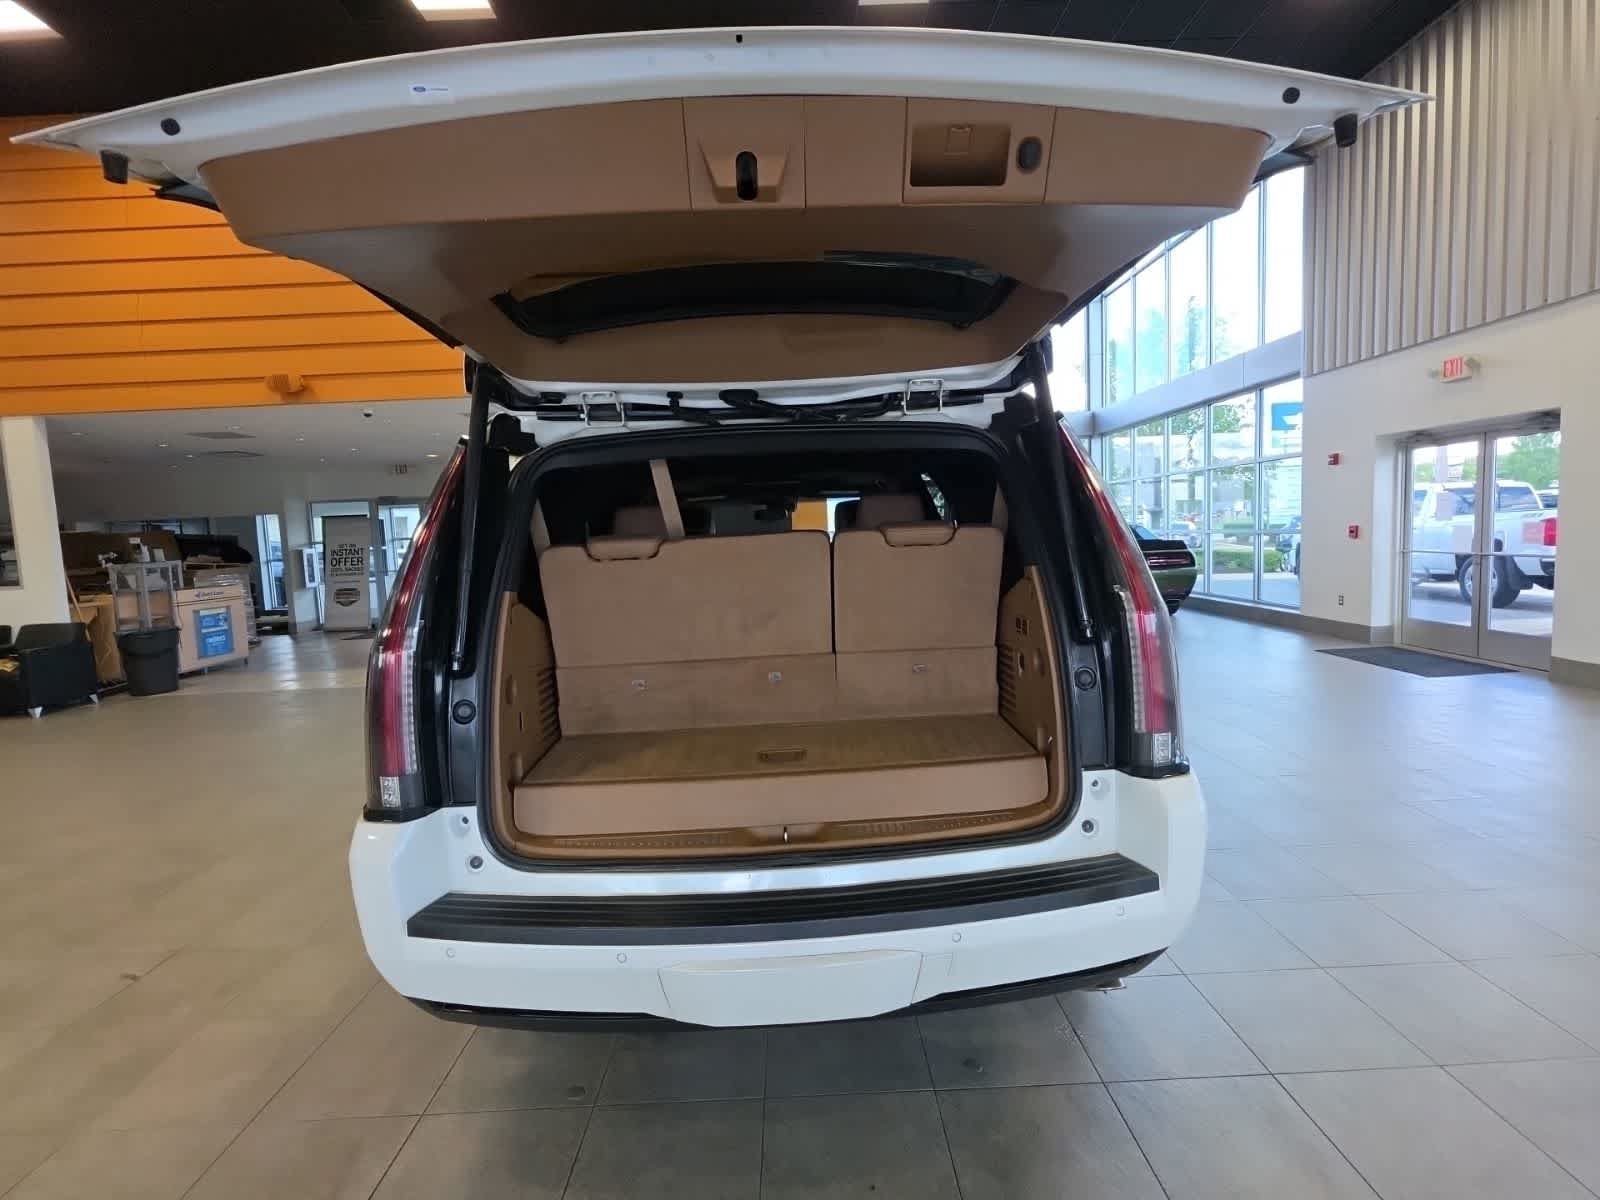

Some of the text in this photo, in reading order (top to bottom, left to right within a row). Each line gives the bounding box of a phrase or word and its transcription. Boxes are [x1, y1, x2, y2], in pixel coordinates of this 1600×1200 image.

[1443, 357, 1464, 378] EXIT
[330, 547, 364, 557] INSTANT
[330, 556, 364, 568] OFFER
